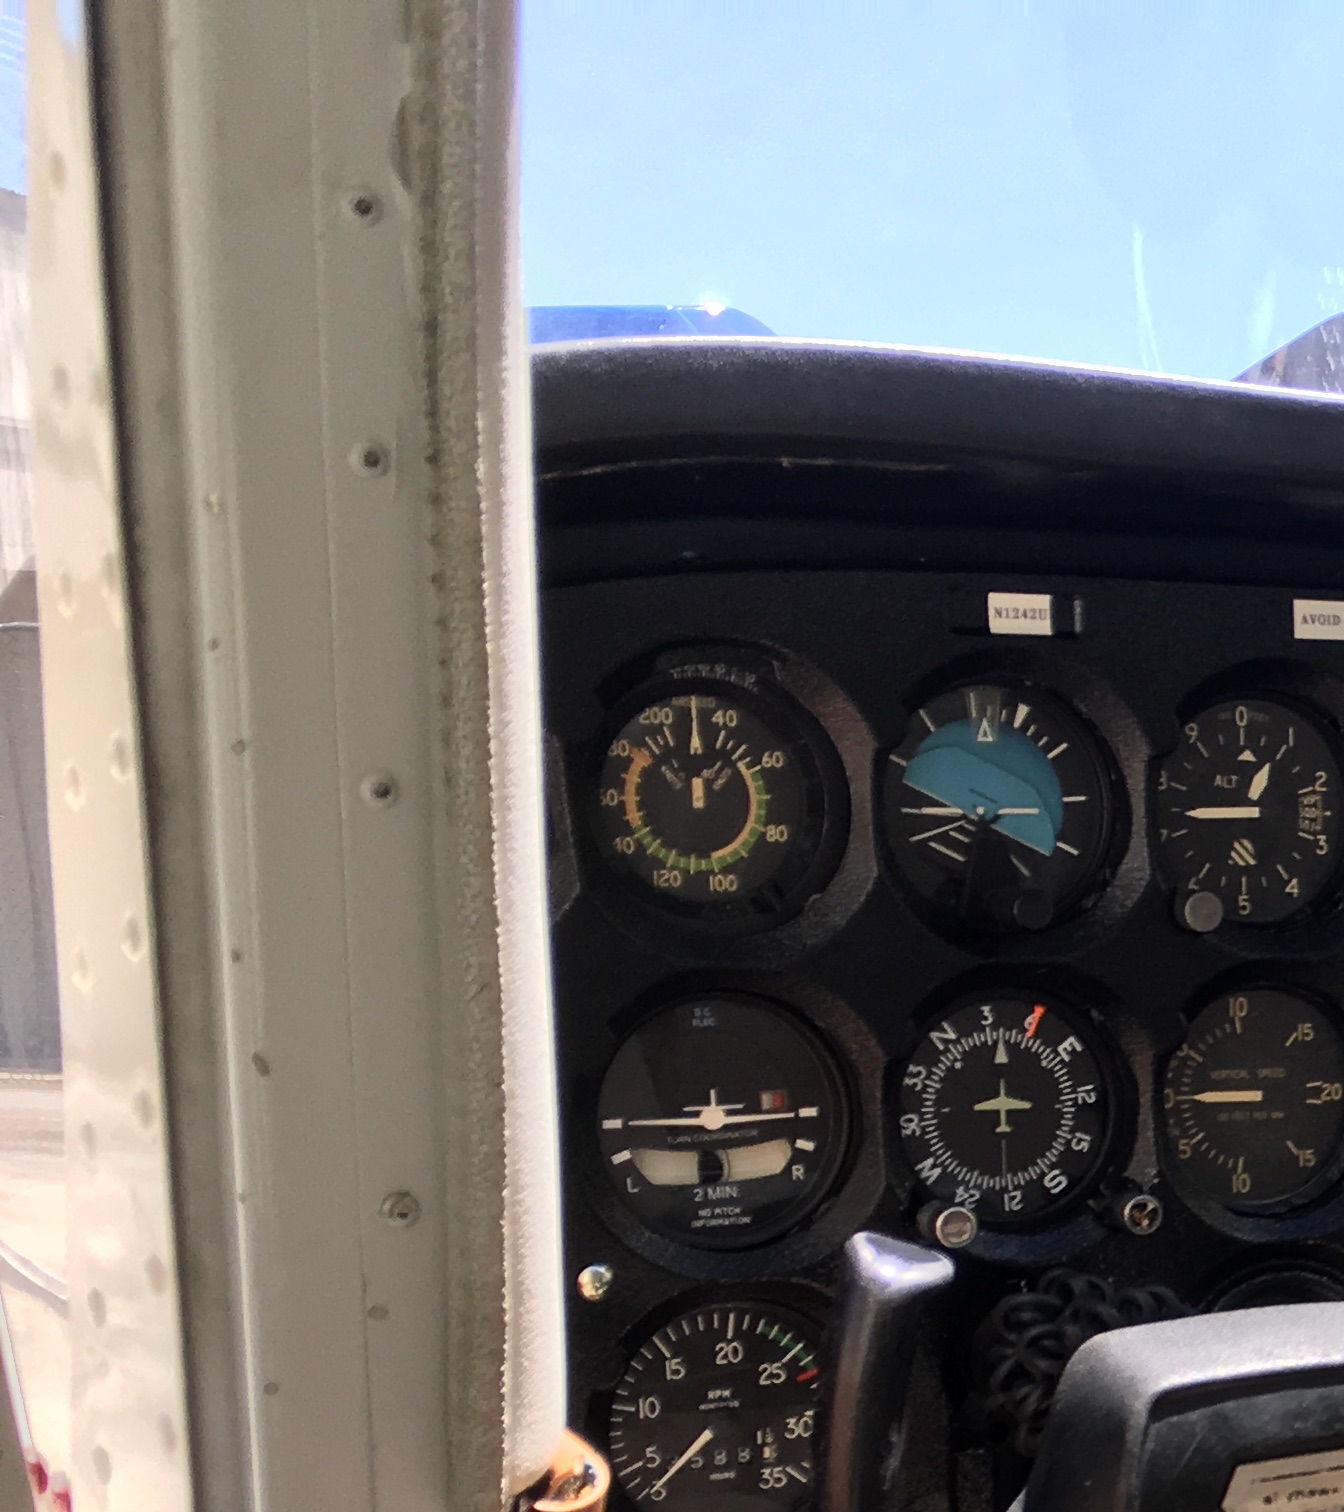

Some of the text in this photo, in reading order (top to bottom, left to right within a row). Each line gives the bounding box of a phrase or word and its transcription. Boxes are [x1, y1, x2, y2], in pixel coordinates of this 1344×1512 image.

[1300, 612, 1342, 626] AVOID
[638, 707, 673, 725] 200
[711, 709, 738, 727] 40
[1234, 705, 1248, 727] 0
[1184, 723, 1198, 744] 9
[761, 751, 784, 769] 60
[1213, 774, 1239, 789] ALT
[1314, 771, 1328, 791] 2
[765, 824, 788, 842] 80
[1316, 834, 1328, 855] 3
[653, 869, 682, 887] 120
[708, 874, 738, 892] 100
[1285, 877, 1300, 898] 4
[1238, 894, 1250, 915] 5
[980, 1006, 993, 1025] 3
[1228, 997, 1248, 1018] 10
[928, 1021, 959, 1051] N
[1297, 1023, 1315, 1041] 15
[1056, 1034, 1085, 1063] E
[902, 1064, 927, 1092] 33
[1077, 1084, 1097, 1105] 12
[1320, 1083, 1343, 1101] 20
[899, 1114, 923, 1138] 30
[667, 1134, 692, 1144] TURN
[1071, 1131, 1092, 1153] 15
[1178, 1139, 1192, 1159] 5
[1298, 1149, 1317, 1168] 15
[791, 1164, 805, 1181] R
[914, 1157, 943, 1186] W
[1043, 1168, 1069, 1194] S
[626, 1176, 640, 1194] L
[1231, 1173, 1251, 1194] 10
[693, 1189, 704, 1202] 2
[954, 1185, 981, 1210] 24
[1003, 1191, 1025, 1212] 21
[714, 1340, 744, 1365] 20
[665, 1358, 687, 1381] 15
[758, 1362, 787, 1386] 25
[707, 1388, 732, 1400] RPM
[638, 1396, 661, 1420] 10
[784, 1416, 814, 1439] 30
[644, 1445, 662, 1469] 5
[758, 1466, 788, 1490] 35
